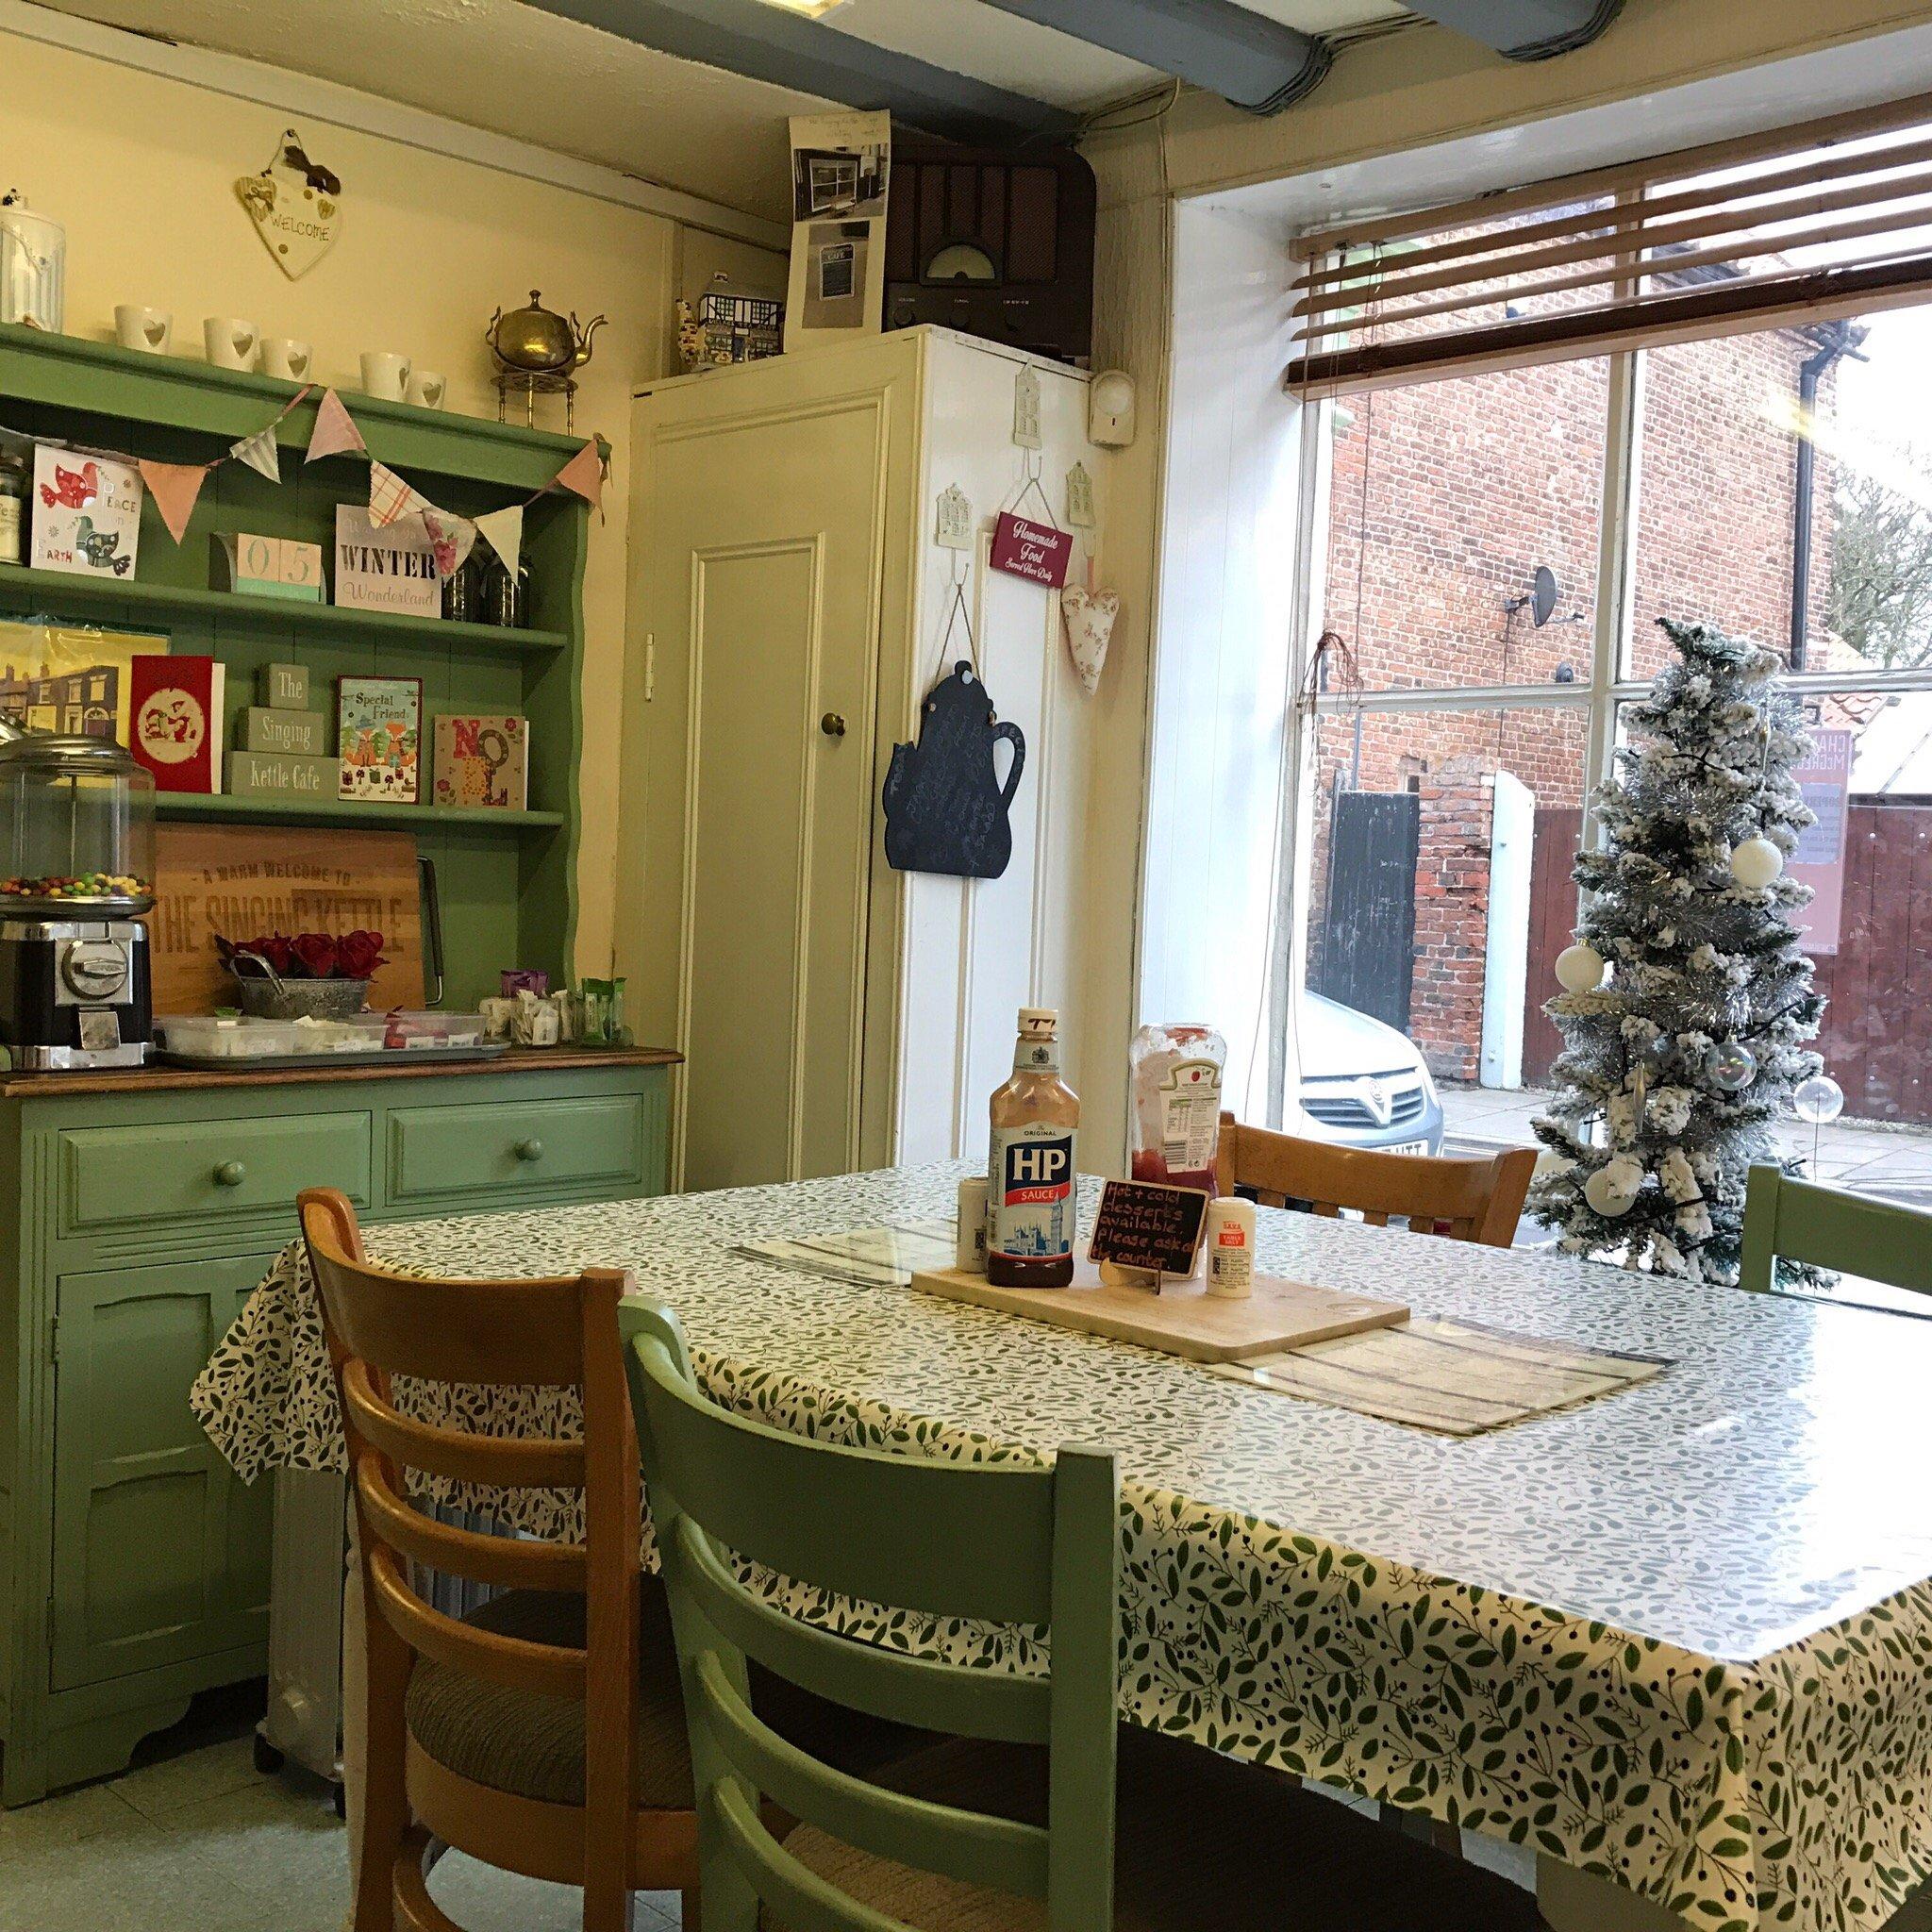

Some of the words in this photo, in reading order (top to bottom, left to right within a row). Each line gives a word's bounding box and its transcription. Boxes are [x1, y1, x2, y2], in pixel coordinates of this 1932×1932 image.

[271, 213, 330, 242] WELCOME
[1013, 521, 1058, 550] Homemade
[341, 544, 436, 580] WINTER
[1020, 542, 1045, 564] Food
[1005, 558, 1024, 571] Served
[1024, 562, 1038, 575] Here
[1038, 567, 1053, 582] Daily
[342, 581, 434, 607] Wonderland
[278, 672, 303, 699] The
[356, 691, 394, 707] Special
[373, 705, 407, 720] Friend
[262, 715, 311, 750] Singing
[250, 759, 289, 789] Kettle
[292, 764, 320, 791] Cafe
[203, 869, 213, 884] A
[216, 863, 258, 882] WARM
[264, 861, 329, 882] WELCOME
[335, 868, 351, 886] TO
[154, 895, 199, 954] THE
[206, 895, 308, 953] SINGING
[315, 897, 405, 953] KETTLE
[1012, 1148, 1066, 1181] HP
[1021, 1188, 1054, 1201] SAUCE
[1108, 1182, 1132, 1197] Hot
[1147, 1190, 1180, 1204] cold
[1103, 1196, 1184, 1221] desserts
[1153, 1234, 1181, 1251] ask
